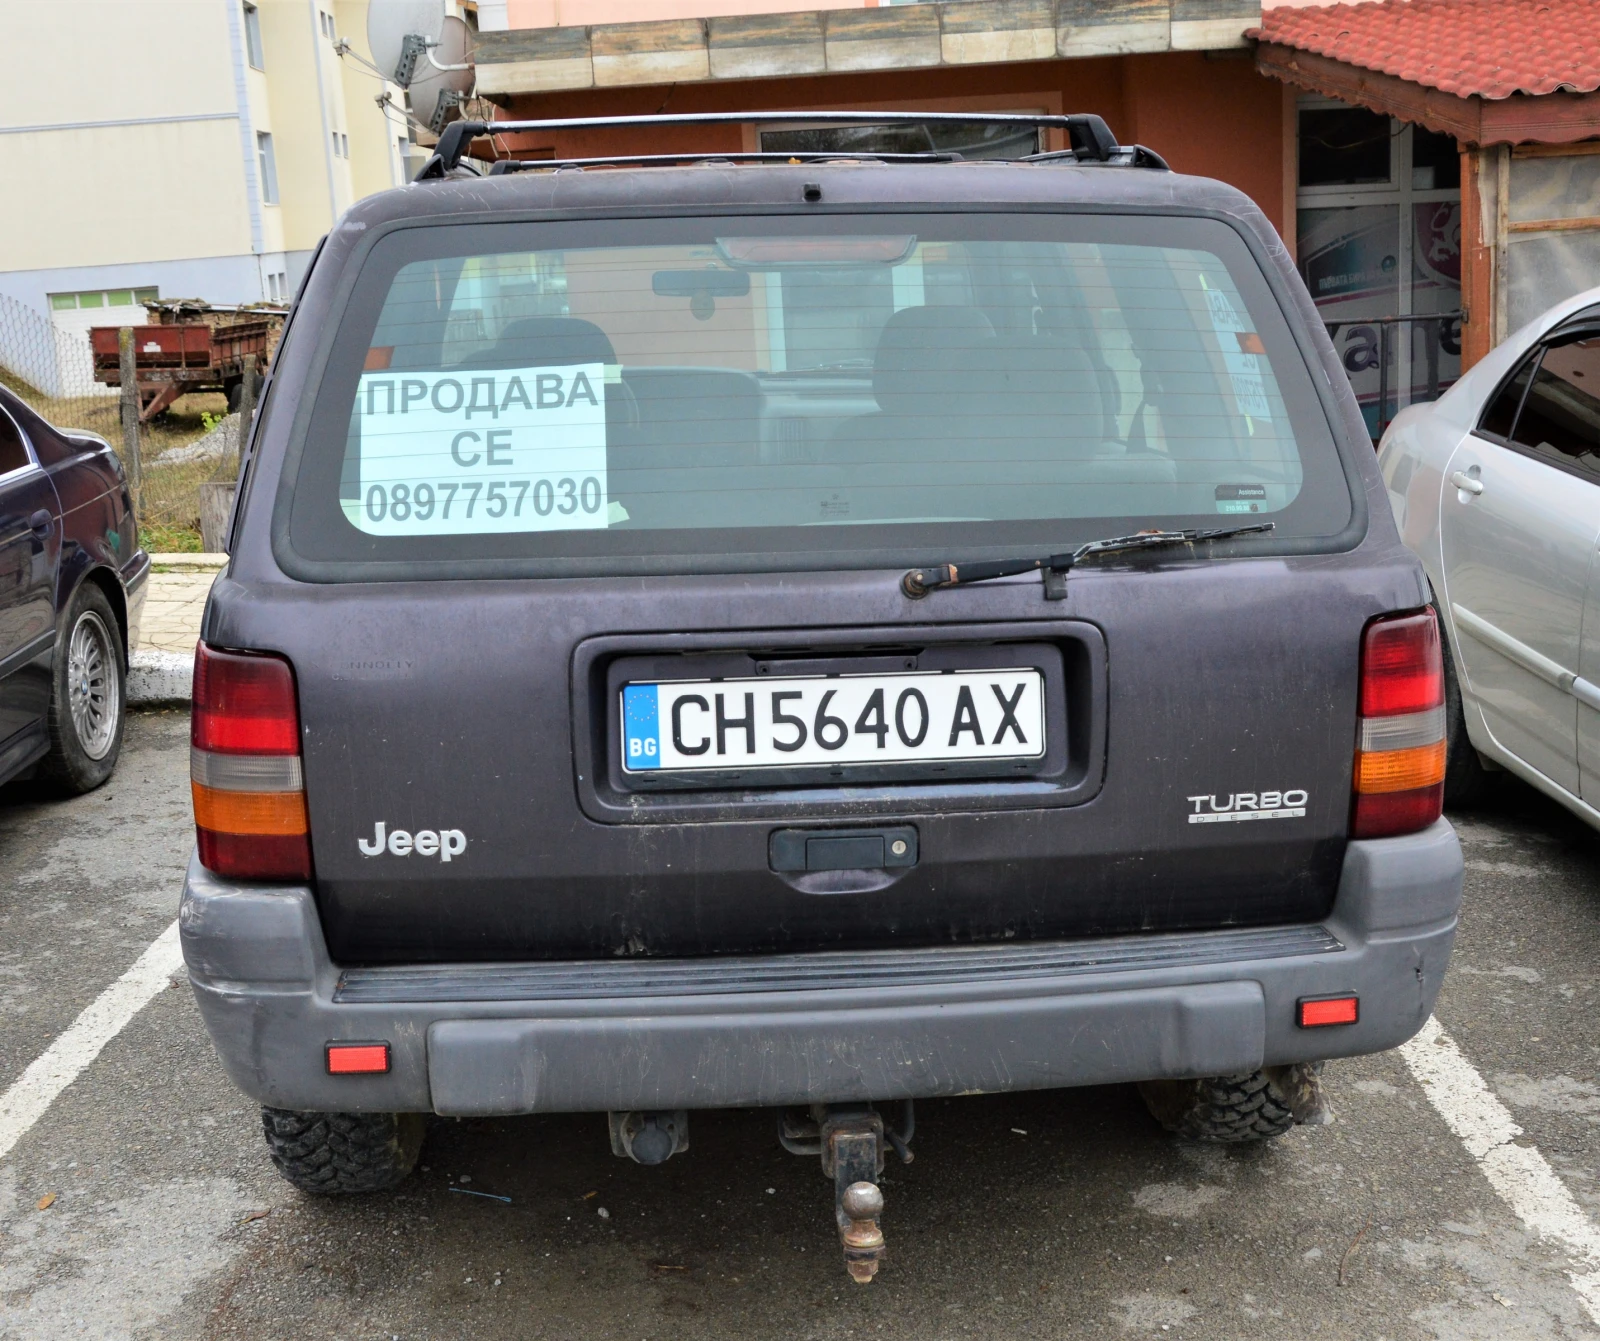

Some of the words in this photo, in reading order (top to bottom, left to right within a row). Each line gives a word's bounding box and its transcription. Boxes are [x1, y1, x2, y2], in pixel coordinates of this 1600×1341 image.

[366, 371, 599, 420] ПРОДАВА
[450, 429, 514, 468] СЕ
[366, 476, 602, 522] 0897757030
[948, 683, 1028, 747] AX
[629, 737, 657, 757] BG
[1186, 789, 1309, 813] TURBO
[1196, 811, 1300, 823] DIESEL
[358, 821, 467, 862] Jeep
